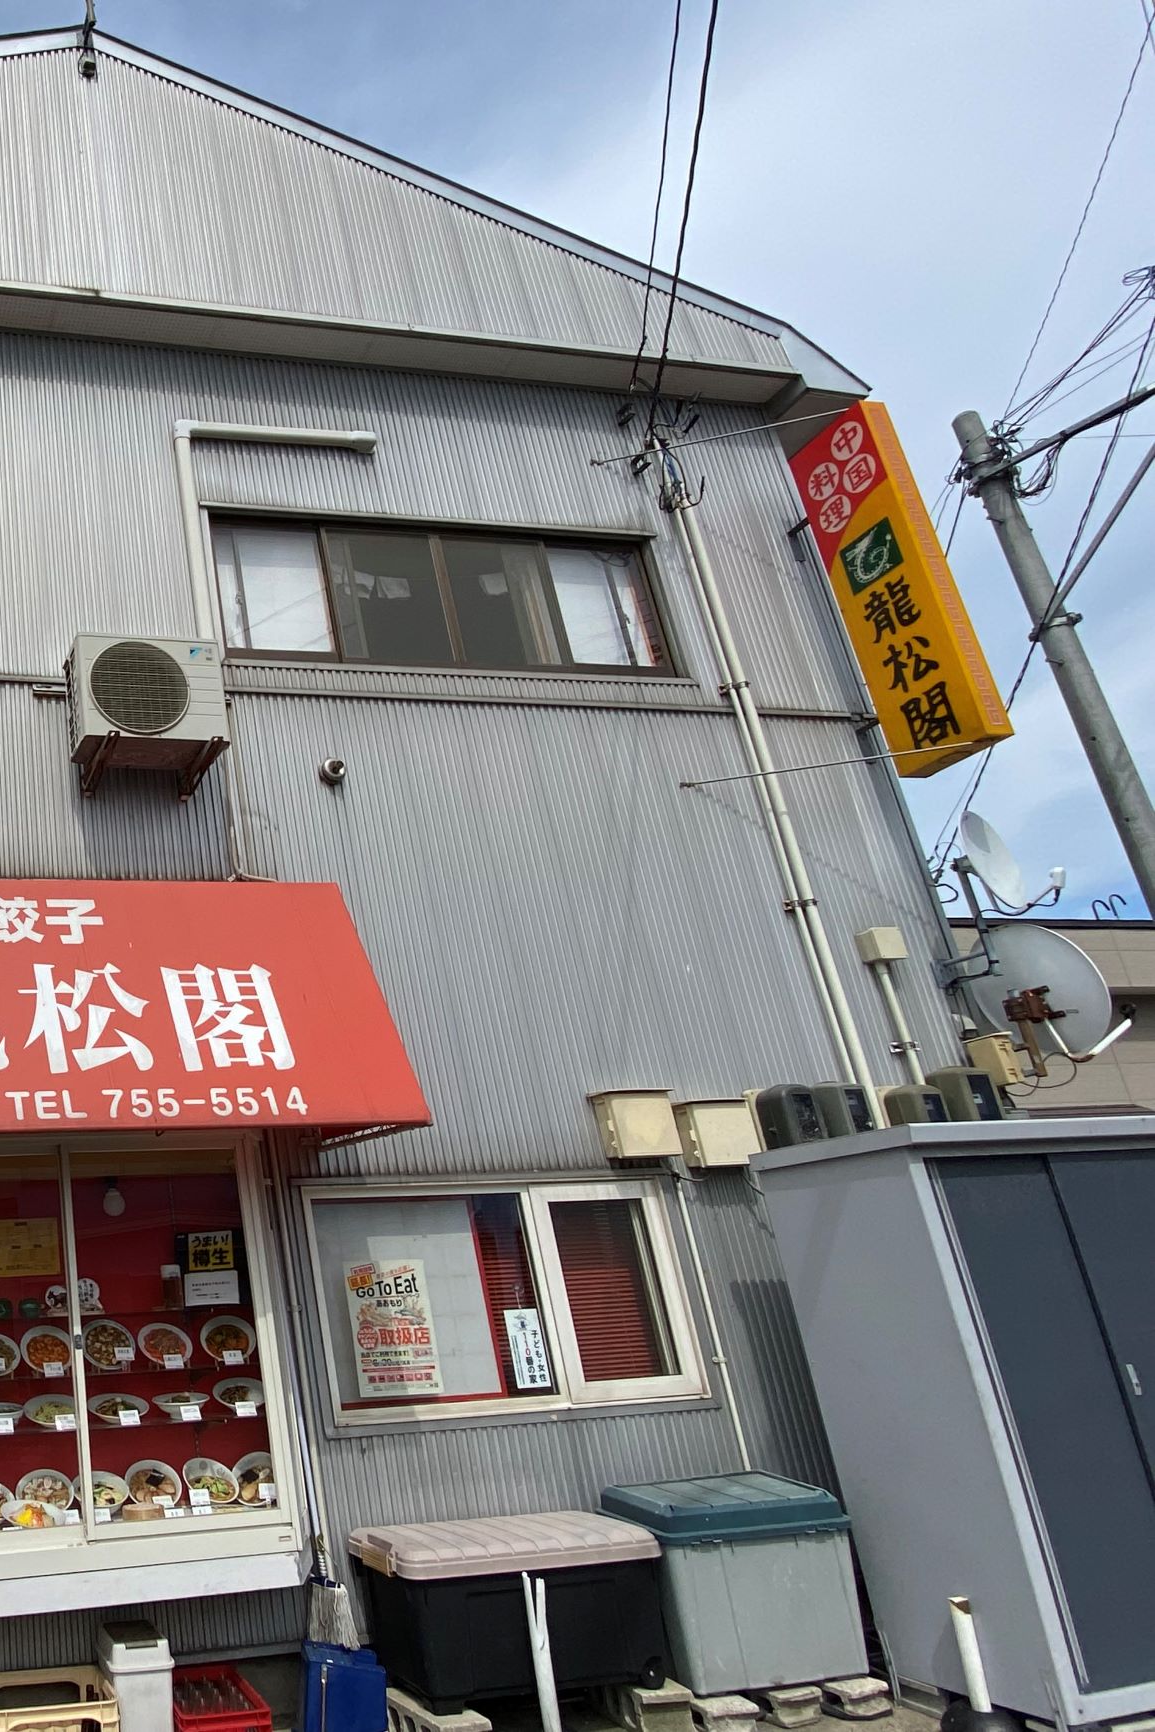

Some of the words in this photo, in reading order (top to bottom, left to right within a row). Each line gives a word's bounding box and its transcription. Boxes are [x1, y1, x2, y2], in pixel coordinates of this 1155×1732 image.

[863, 574, 960, 750] 龍松閣
[5, 1089, 88, 1121] TEL
[101, 1086, 309, 1119] 755-5514
[356, 1286, 375, 1298] Go
[375, 1280, 392, 1297] To
[393, 1273, 420, 1295] Eat
[378, 1326, 431, 1346] 取扱店
